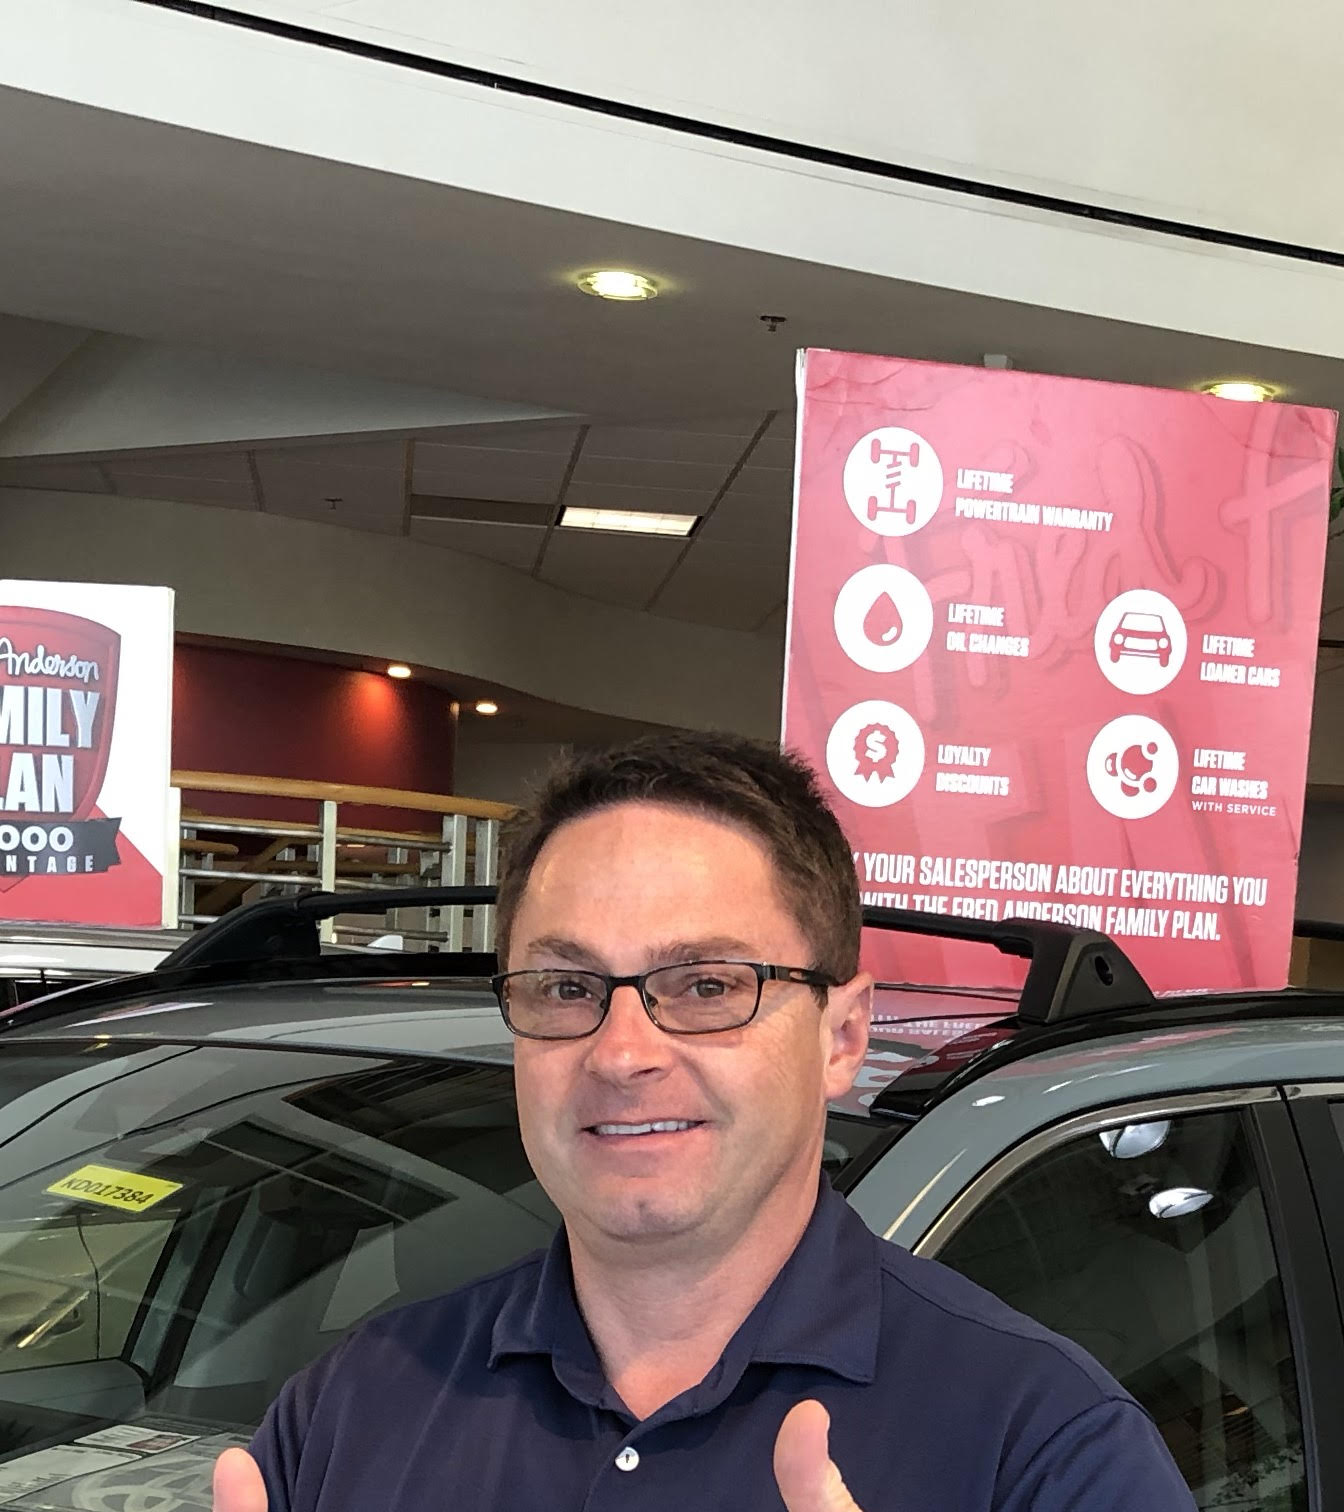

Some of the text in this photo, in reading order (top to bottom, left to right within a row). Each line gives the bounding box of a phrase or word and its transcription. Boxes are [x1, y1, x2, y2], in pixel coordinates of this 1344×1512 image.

[956, 468, 1014, 494] LIFETIME
[955, 496, 1114, 532] POWERTRAIN WARRANTY
[947, 603, 1005, 627] LIFETIME
[946, 631, 1030, 657] OIL CHANGES
[1202, 633, 1256, 658] LIFETIME
[1200, 661, 1281, 688] LOANER CARS
[937, 744, 992, 767] LOYALTY
[1193, 748, 1247, 771] LIFETIME
[935, 772, 1010, 796] DISCOUNTS
[1192, 775, 1269, 800] CAR WASHES
[1191, 800, 1278, 817] WITH SERVICE
[863, 853, 915, 884] YOUR
[919, 856, 1052, 893] SALESPERSON
[1054, 865, 1118, 897] ABOUT
[1120, 869, 1229, 904] EVERYTHING
[1232, 876, 1268, 907] YOU
[912, 894, 949, 915] THE
[952, 897, 999, 922] FRED
[1002, 900, 1102, 933] ANDERSON
[1104, 906, 1170, 938] FAMILY
[1171, 910, 1221, 941] PLAN.
[60, 1178, 154, 1204] KD017384
